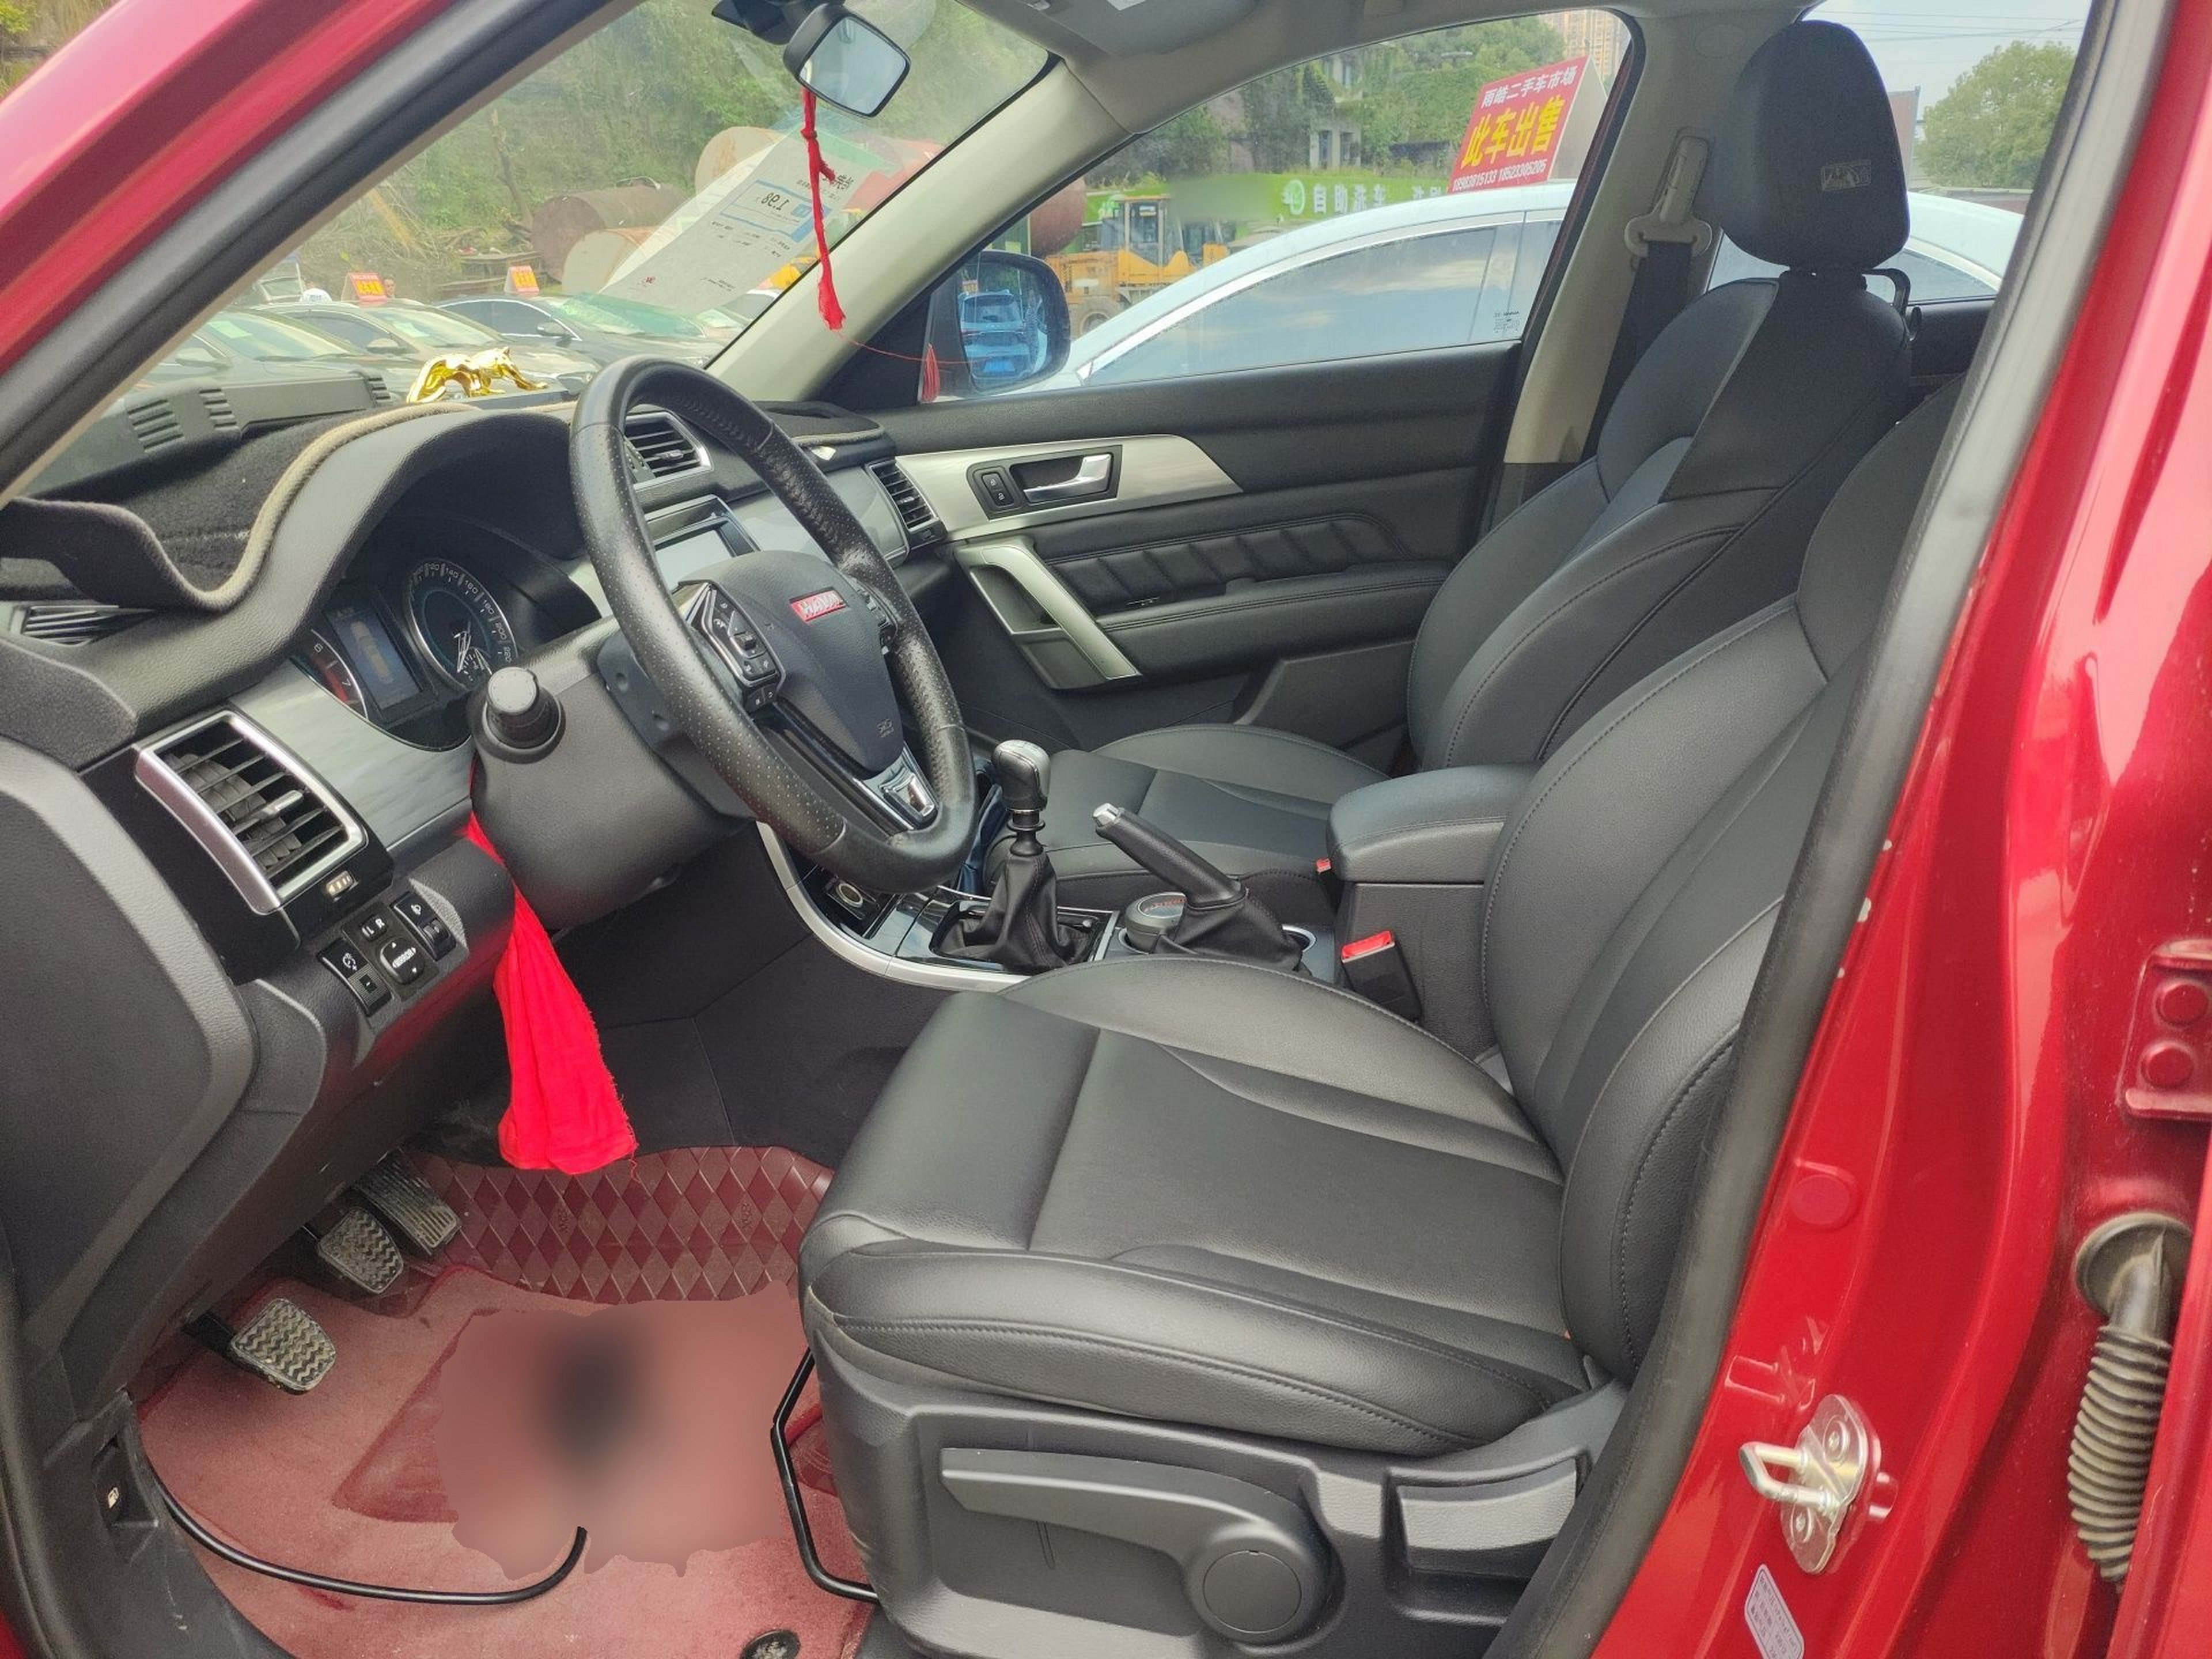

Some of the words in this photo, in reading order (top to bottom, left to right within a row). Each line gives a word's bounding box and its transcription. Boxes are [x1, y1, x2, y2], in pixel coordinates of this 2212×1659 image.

[1461, 94, 1566, 169] 此车出售
[445, 567, 459, 578] 140
[375, 918, 385, 929] R
